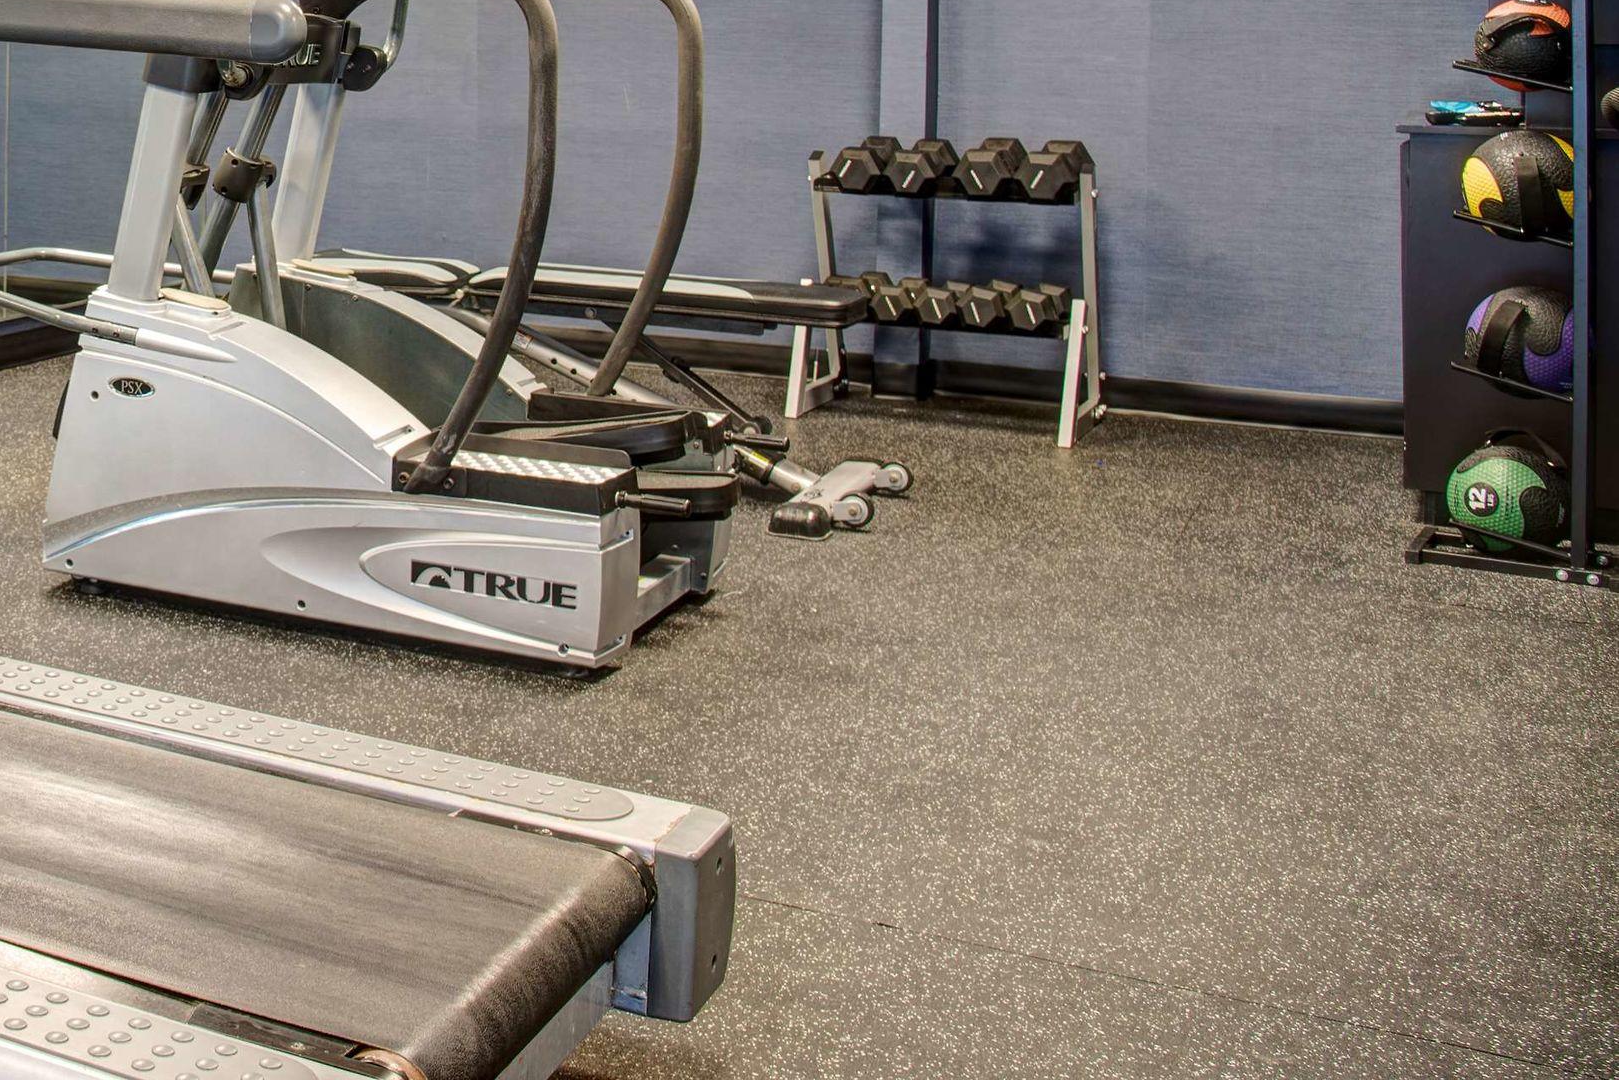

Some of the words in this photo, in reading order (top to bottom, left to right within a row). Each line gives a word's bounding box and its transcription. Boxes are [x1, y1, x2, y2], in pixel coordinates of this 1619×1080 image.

[121, 380, 143, 395] PSX
[1468, 487, 1487, 510] 12
[453, 567, 577, 610] TRUE
